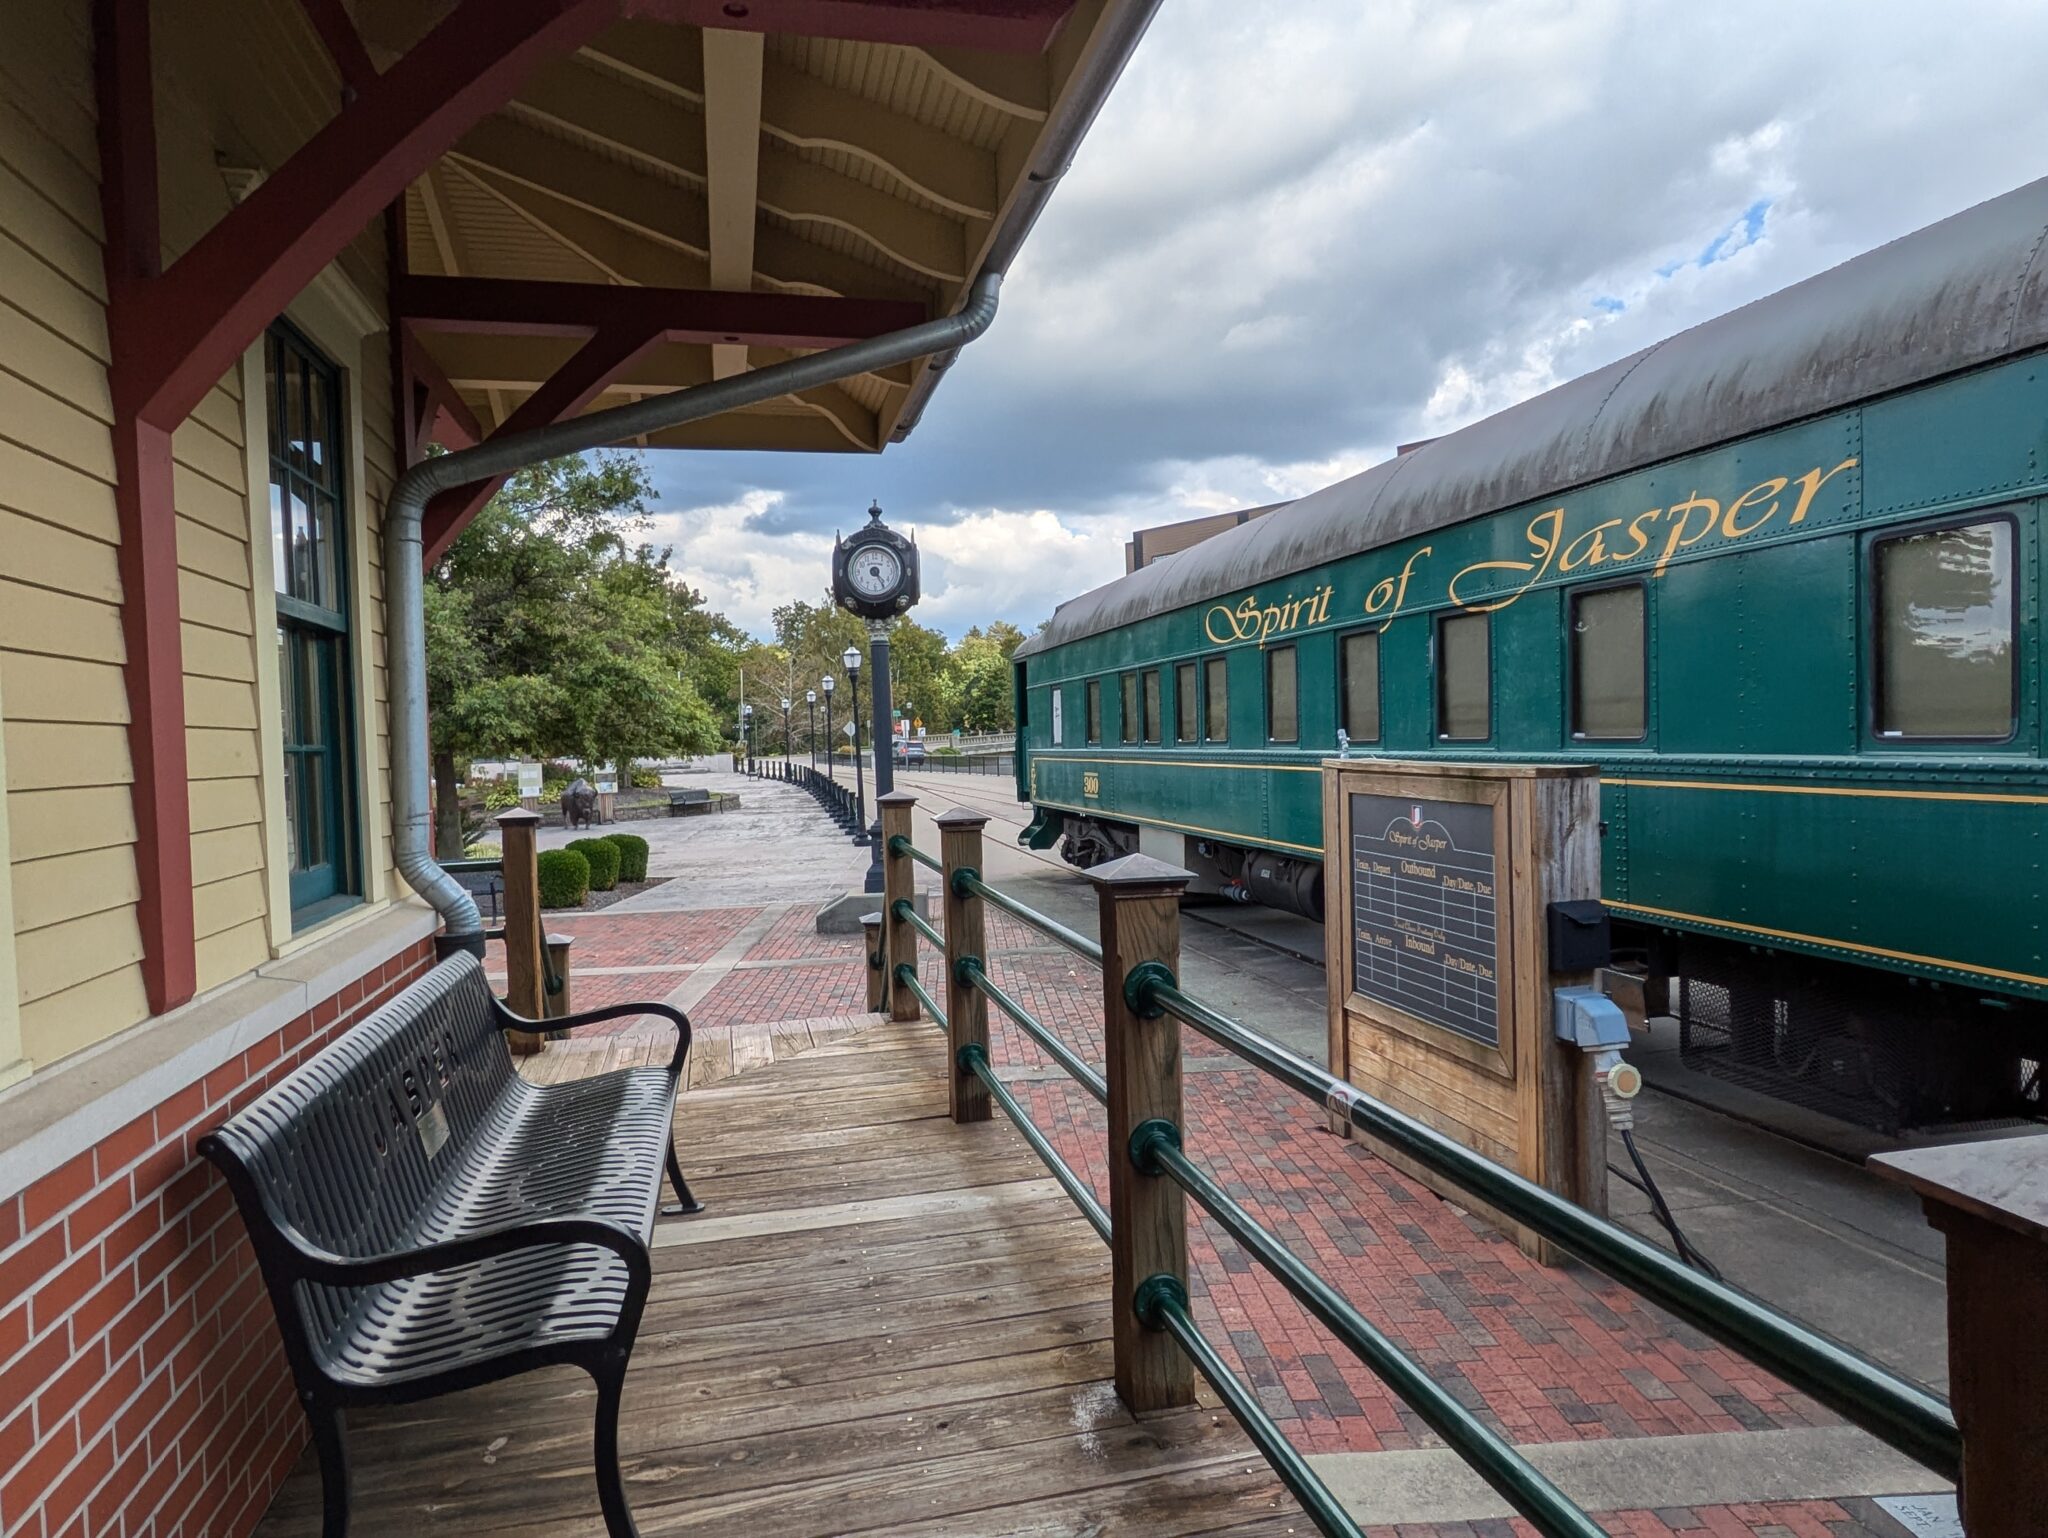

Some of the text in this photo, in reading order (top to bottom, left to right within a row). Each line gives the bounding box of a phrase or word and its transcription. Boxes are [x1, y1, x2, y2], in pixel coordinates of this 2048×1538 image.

[1204, 458, 1858, 650] Spirit of Jasper
[1083, 776, 1099, 794] 300
[1401, 860, 1436, 878] Outbound
[1476, 881, 1492, 895] Due
[1405, 934, 1435, 955] Inbound
[1478, 963, 1493, 978] Due
